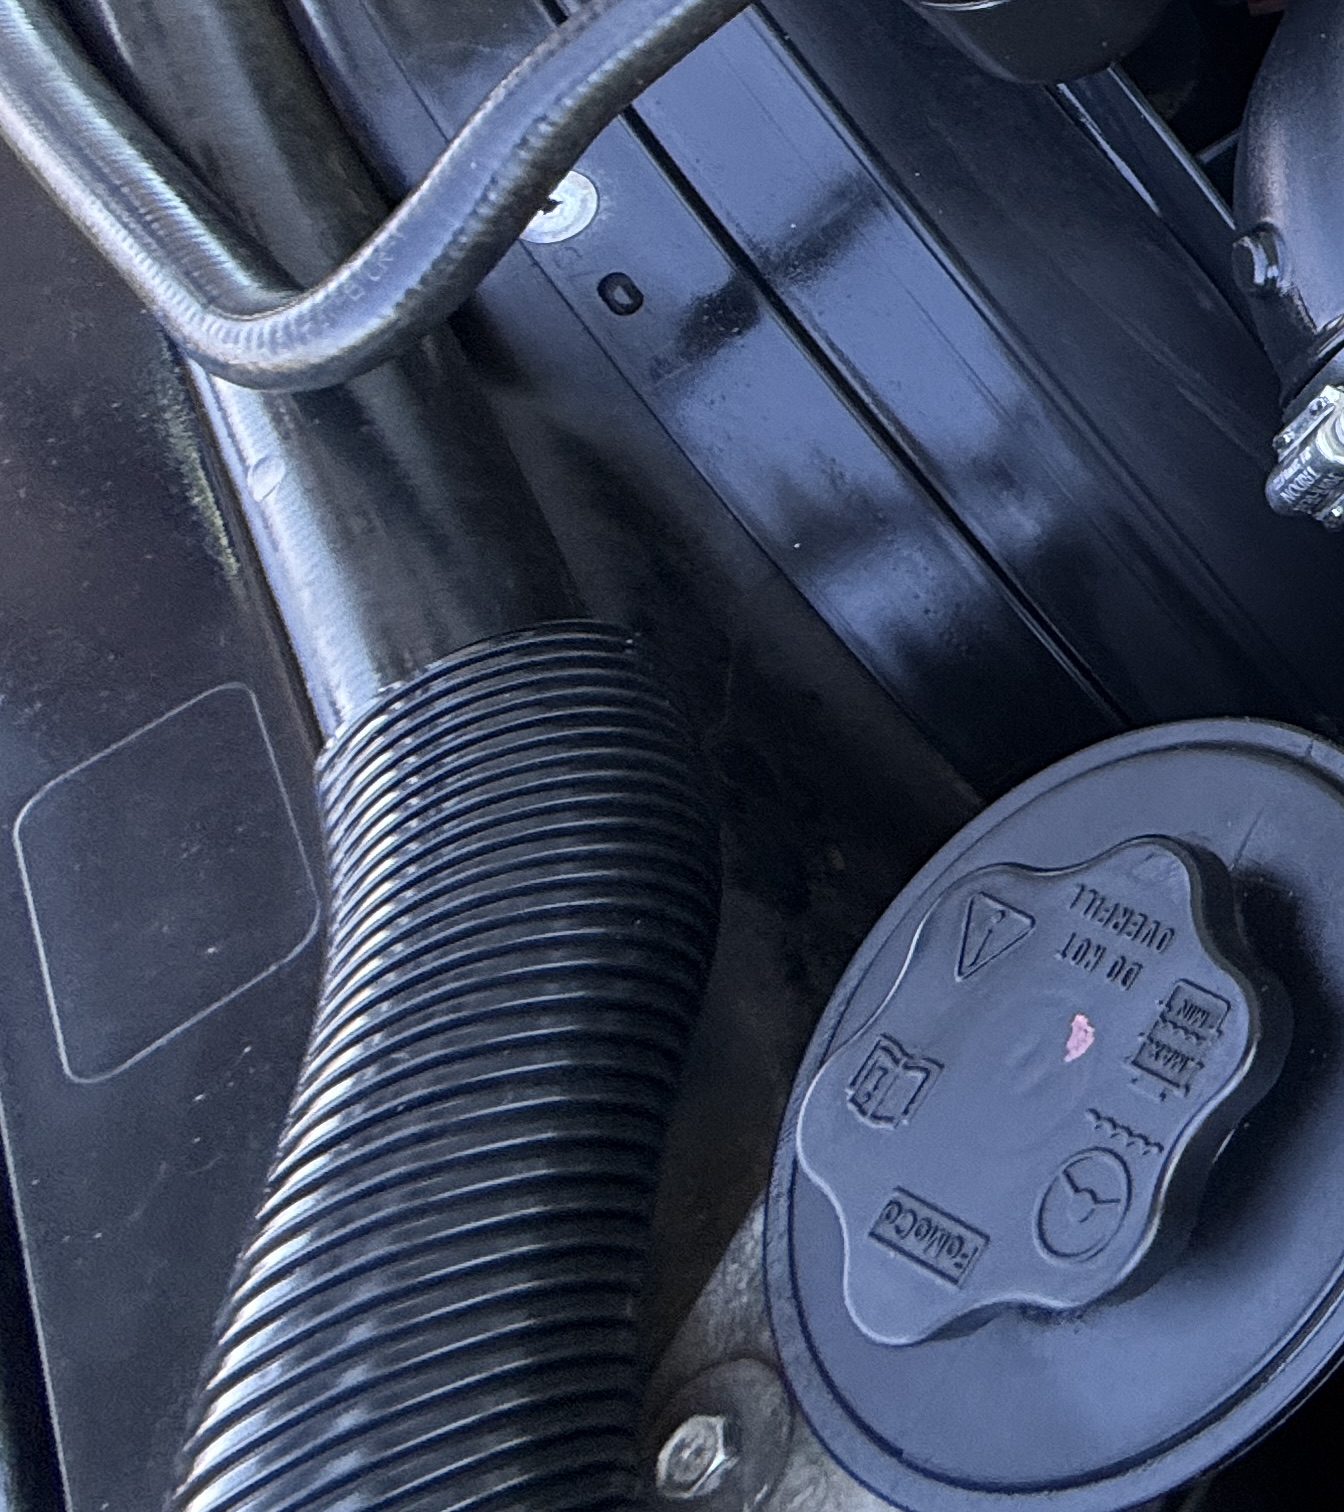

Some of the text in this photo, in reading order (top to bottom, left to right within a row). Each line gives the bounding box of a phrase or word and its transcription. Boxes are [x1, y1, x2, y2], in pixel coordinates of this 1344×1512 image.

[1065, 879, 1177, 956] OVERFILL
[1052, 927, 1144, 993] DO NOT
[1173, 996, 1212, 1029] MIN
[1145, 1037, 1191, 1075] MAX
[873, 1195, 981, 1274] FoMoCo
